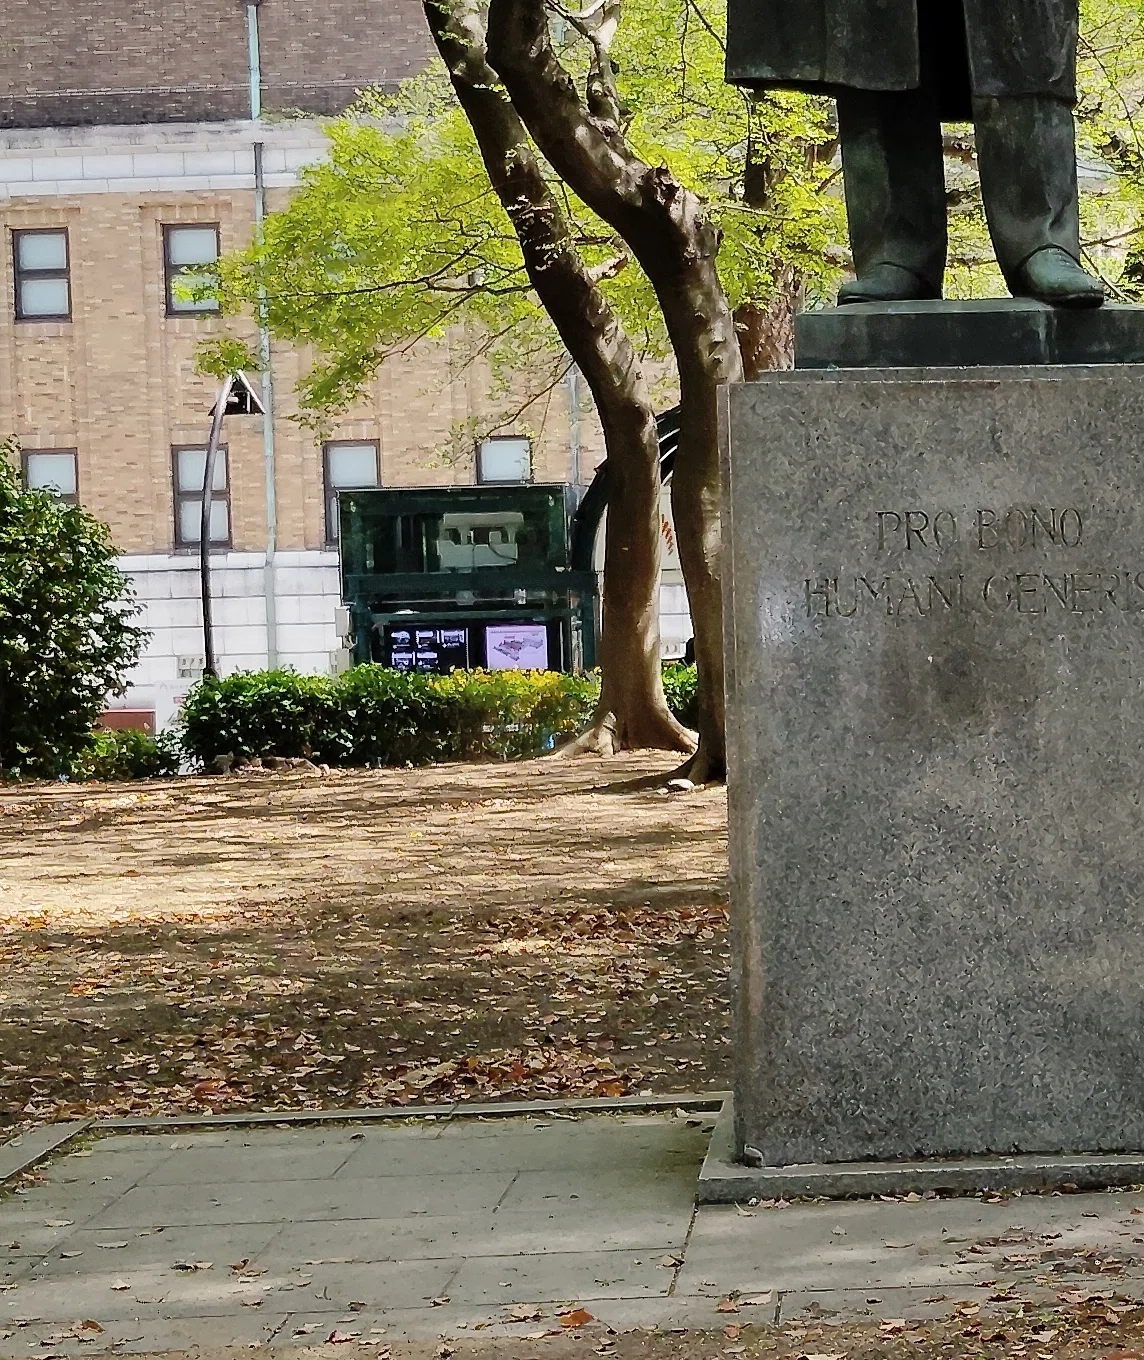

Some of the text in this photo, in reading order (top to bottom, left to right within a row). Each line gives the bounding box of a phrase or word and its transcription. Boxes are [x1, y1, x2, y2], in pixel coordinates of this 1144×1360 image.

[875, 506, 1083, 552] PRO BONO
[803, 574, 965, 617] HUMANI
